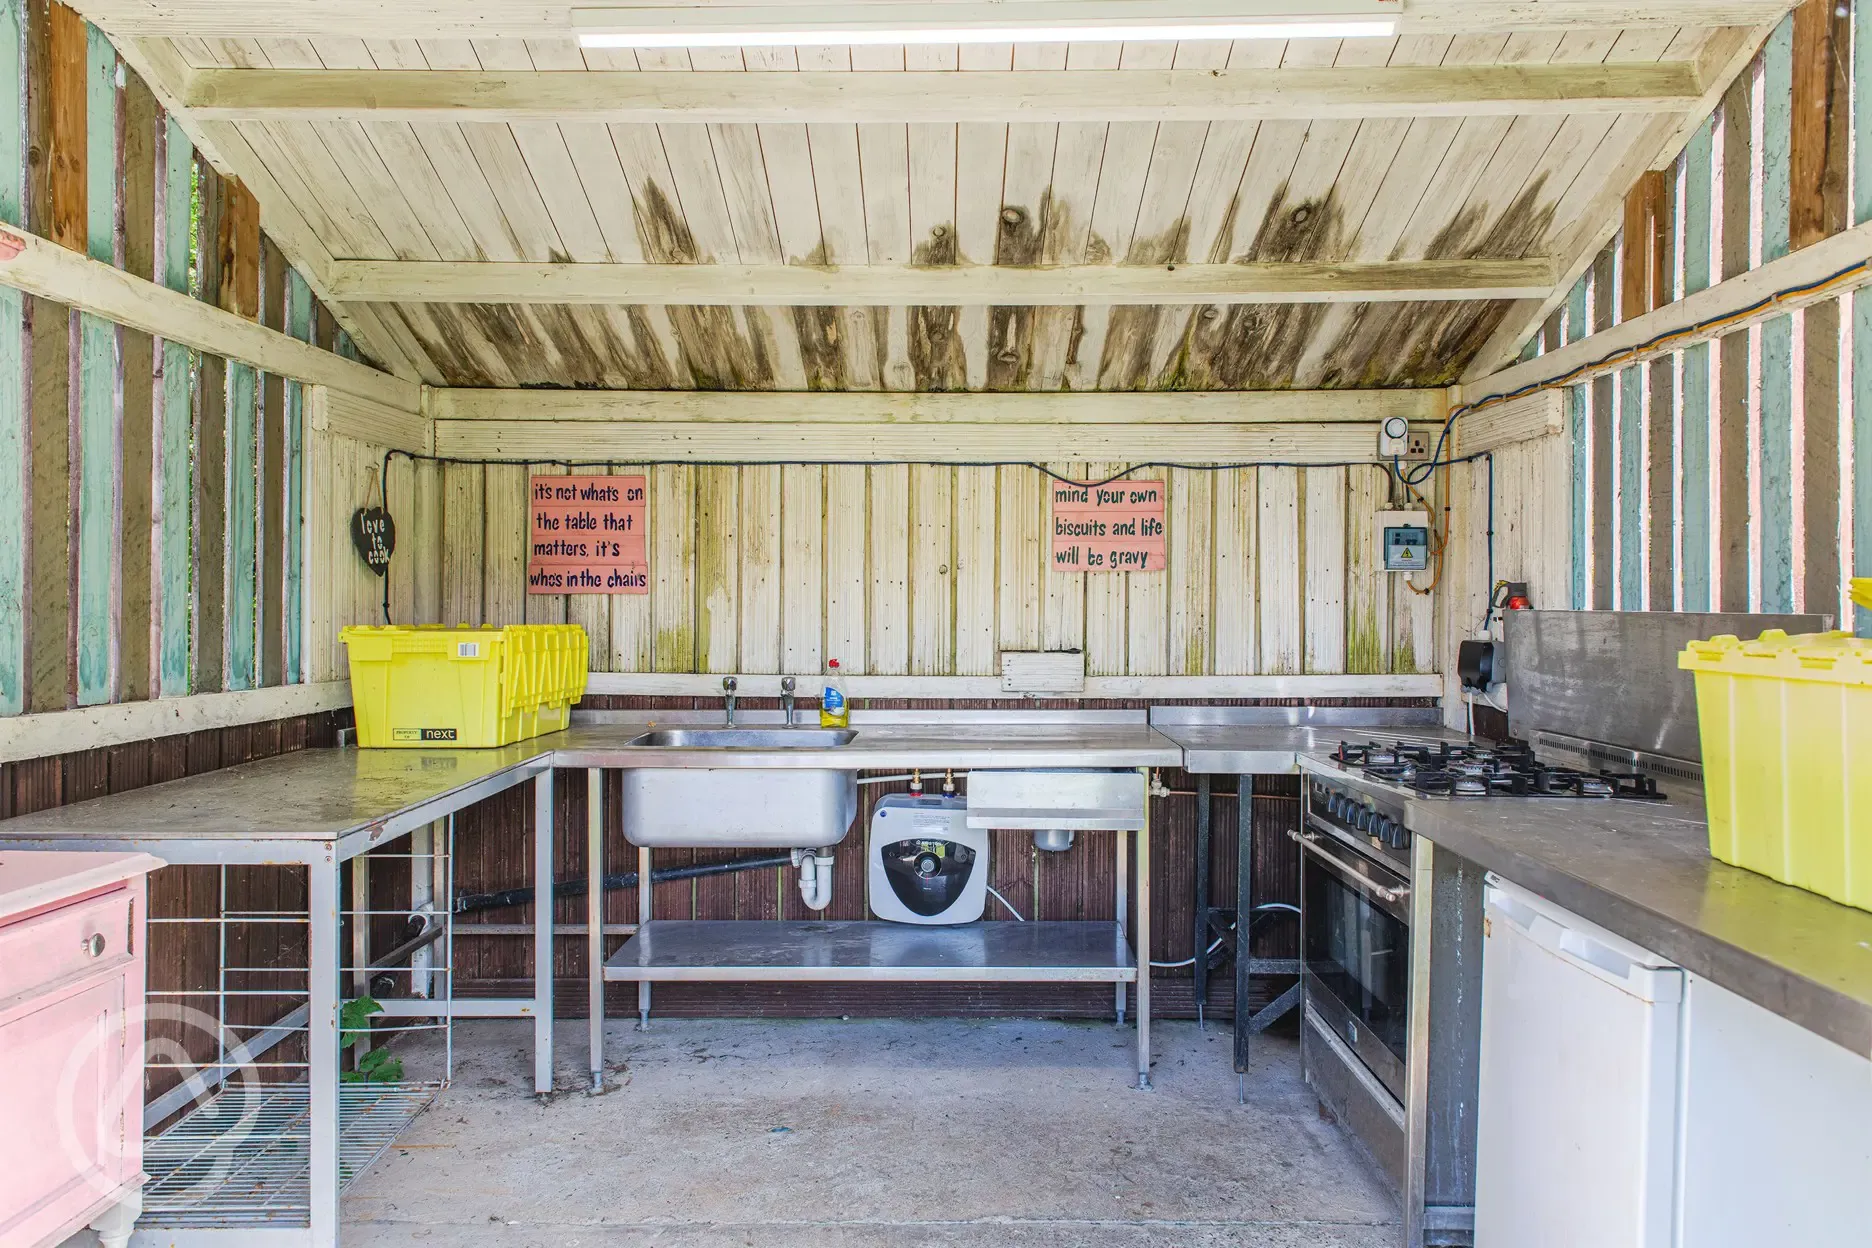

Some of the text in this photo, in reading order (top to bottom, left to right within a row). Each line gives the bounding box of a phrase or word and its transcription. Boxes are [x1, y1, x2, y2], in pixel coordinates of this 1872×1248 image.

[534, 483, 643, 502] it's not what's on
[1055, 486, 1157, 507] mind your own
[360, 512, 385, 535] love
[536, 511, 633, 531] the table that
[1055, 517, 1163, 537] biscuits and life
[371, 532, 383, 550] to
[534, 539, 620, 558] matters, it's
[368, 546, 390, 564] cook
[1056, 546, 1149, 569] will be gravy
[530, 568, 562, 587] who's
[566, 571, 578, 587] in
[579, 568, 601, 587] the
[426, 730, 455, 739] next
